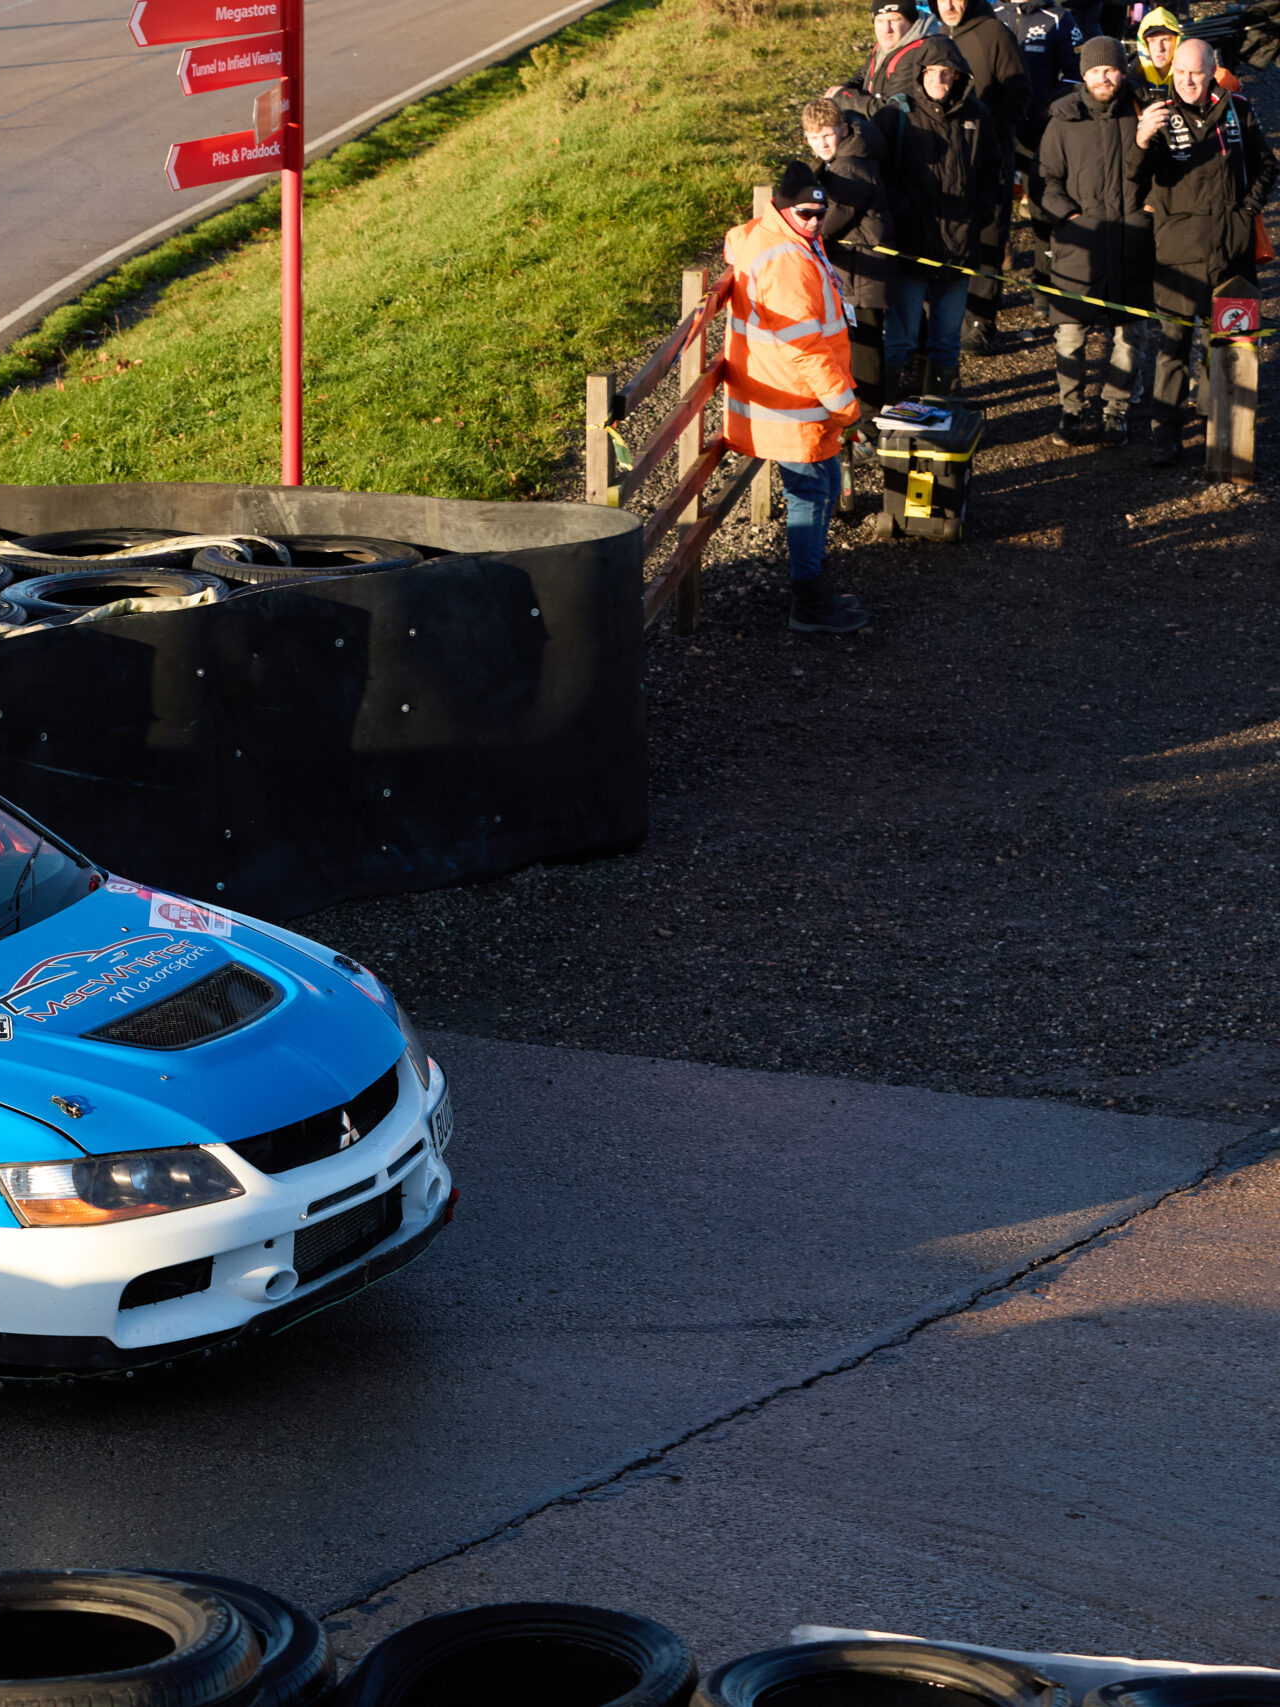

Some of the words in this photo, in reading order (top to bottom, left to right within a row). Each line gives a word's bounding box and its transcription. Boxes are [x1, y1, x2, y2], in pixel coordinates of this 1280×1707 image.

[216, 4, 277, 22] Megastore
[191, 60, 217, 77] Tunnel
[218, 60, 226, 72] to
[227, 54, 251, 71] Infield
[252, 50, 282, 66] Viewing
[212, 151, 230, 167] Pits
[231, 149, 239, 163] &
[241, 141, 280, 161] Paddock
[24, 939, 197, 1022] MacWhirter
[109, 946, 214, 1004] Motorsport
